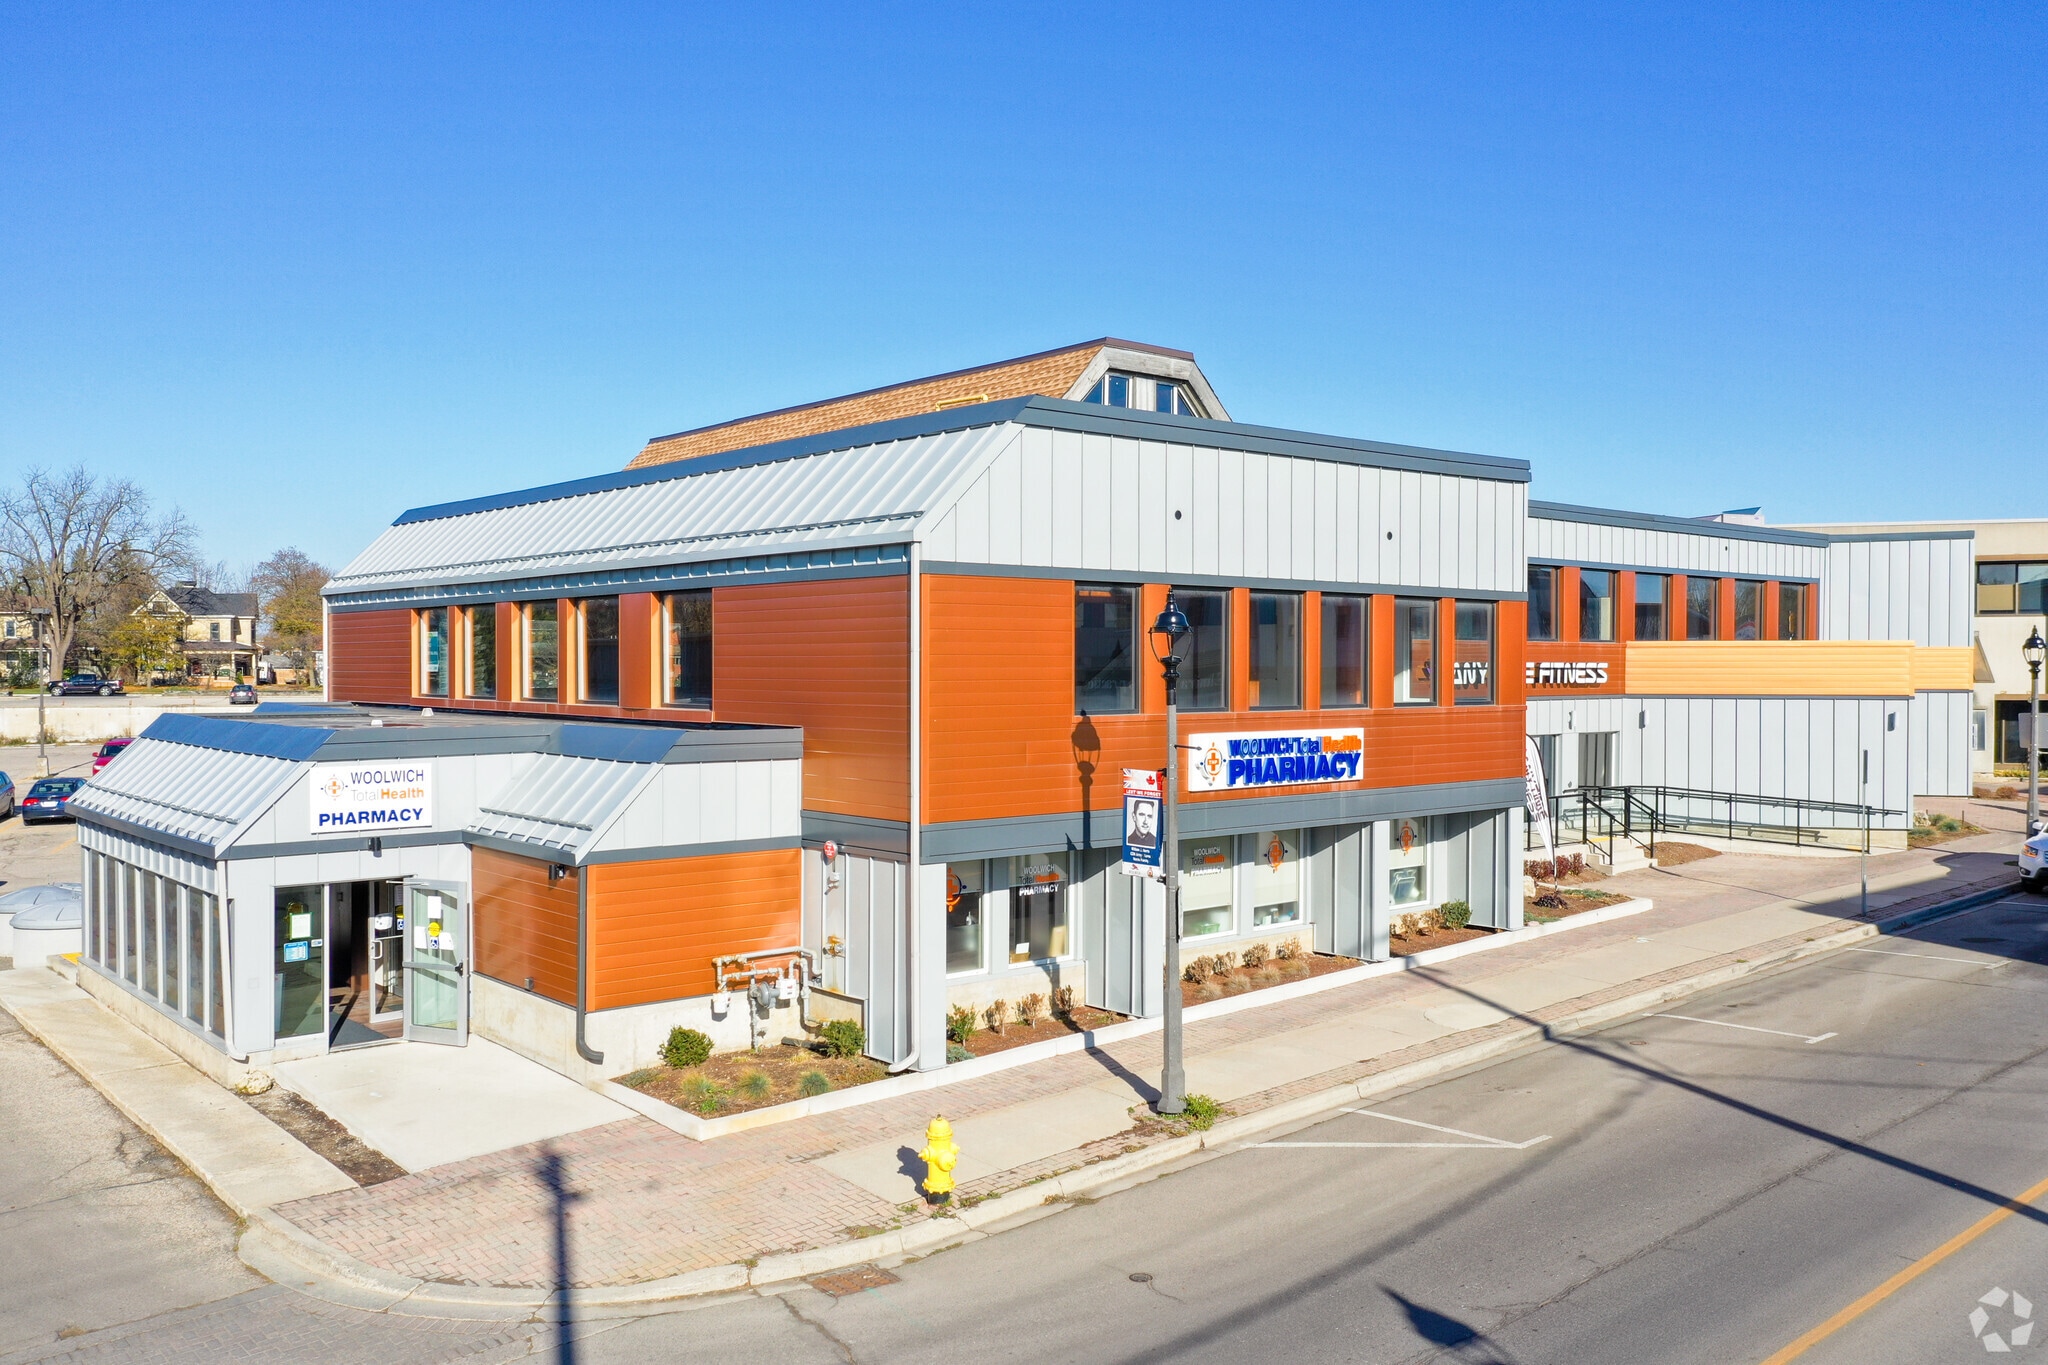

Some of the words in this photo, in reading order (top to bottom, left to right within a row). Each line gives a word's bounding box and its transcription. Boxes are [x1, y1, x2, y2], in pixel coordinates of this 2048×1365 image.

[1539, 662, 1608, 684] FITNESS
[1226, 737, 1293, 757] WOOLWICH
[1322, 735, 1362, 754] Health
[350, 769, 424, 784] WOOLWICH
[1226, 752, 1362, 787] PHARMACY
[350, 788, 379, 801] Total
[380, 787, 424, 799] Health
[319, 807, 423, 826] PHARMACY
[1024, 864, 1055, 874] WOOLWICH
[1019, 884, 1059, 896] PHARMACY
